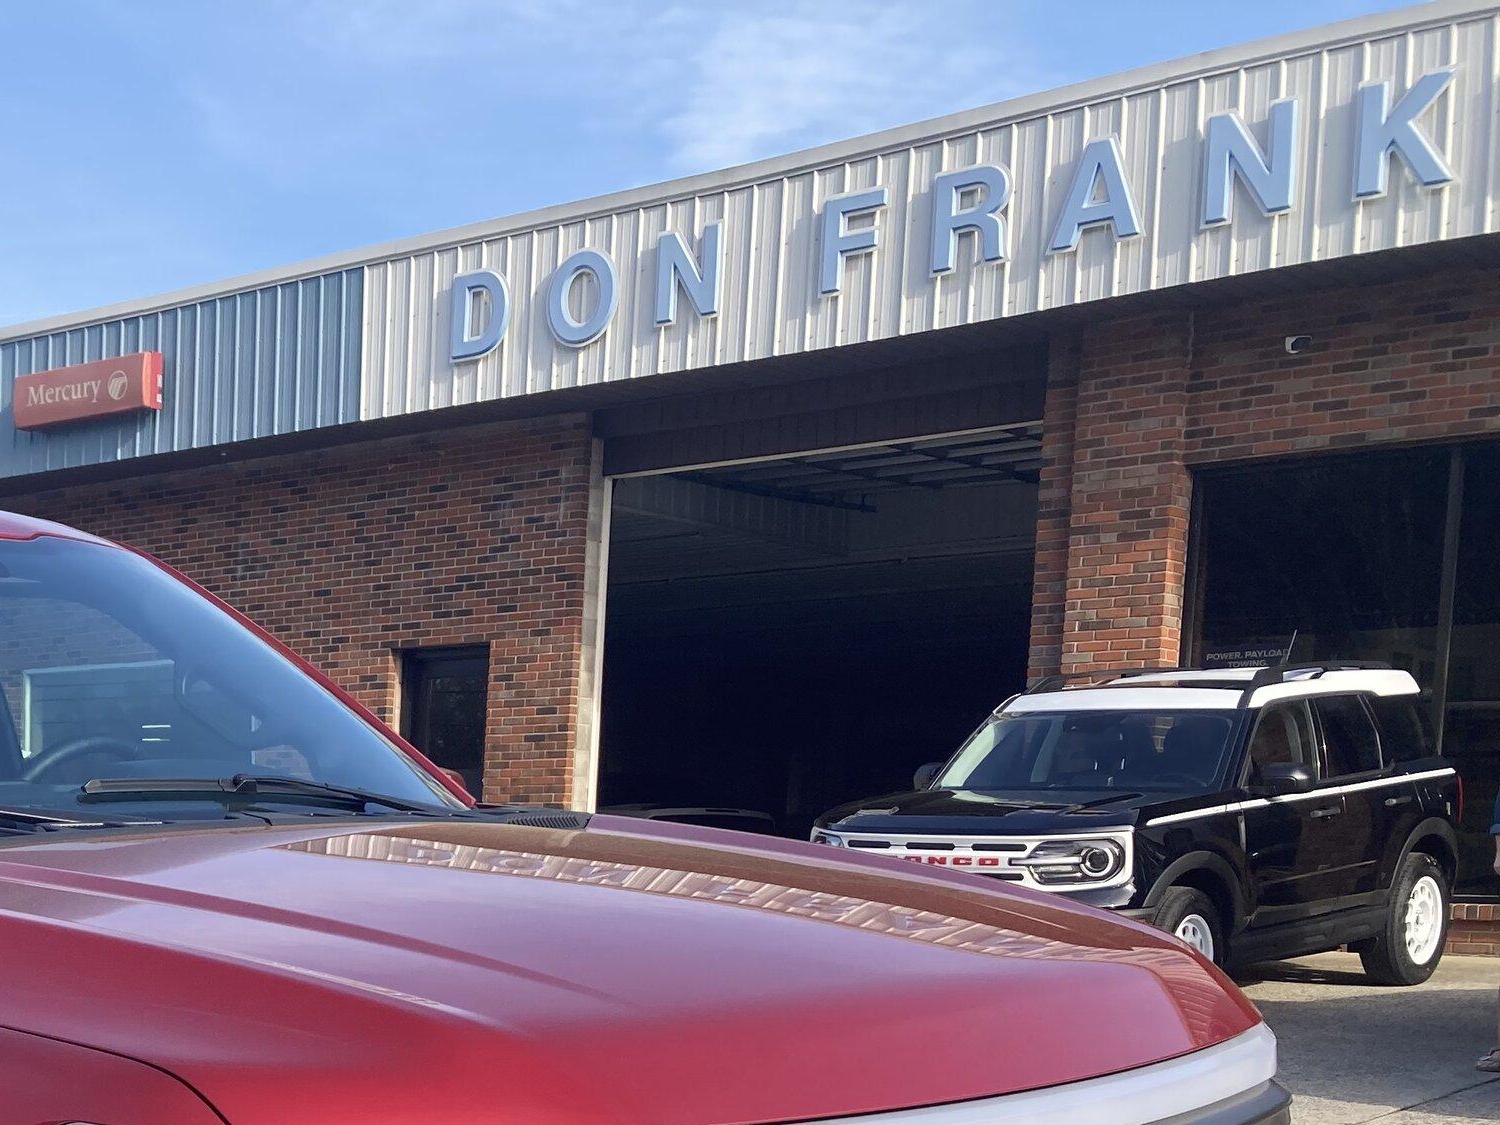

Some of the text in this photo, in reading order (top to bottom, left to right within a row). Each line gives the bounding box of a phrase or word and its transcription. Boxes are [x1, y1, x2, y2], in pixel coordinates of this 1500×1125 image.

[450, 66, 1459, 362] DON FRANK
[27, 380, 101, 407] Mercury
